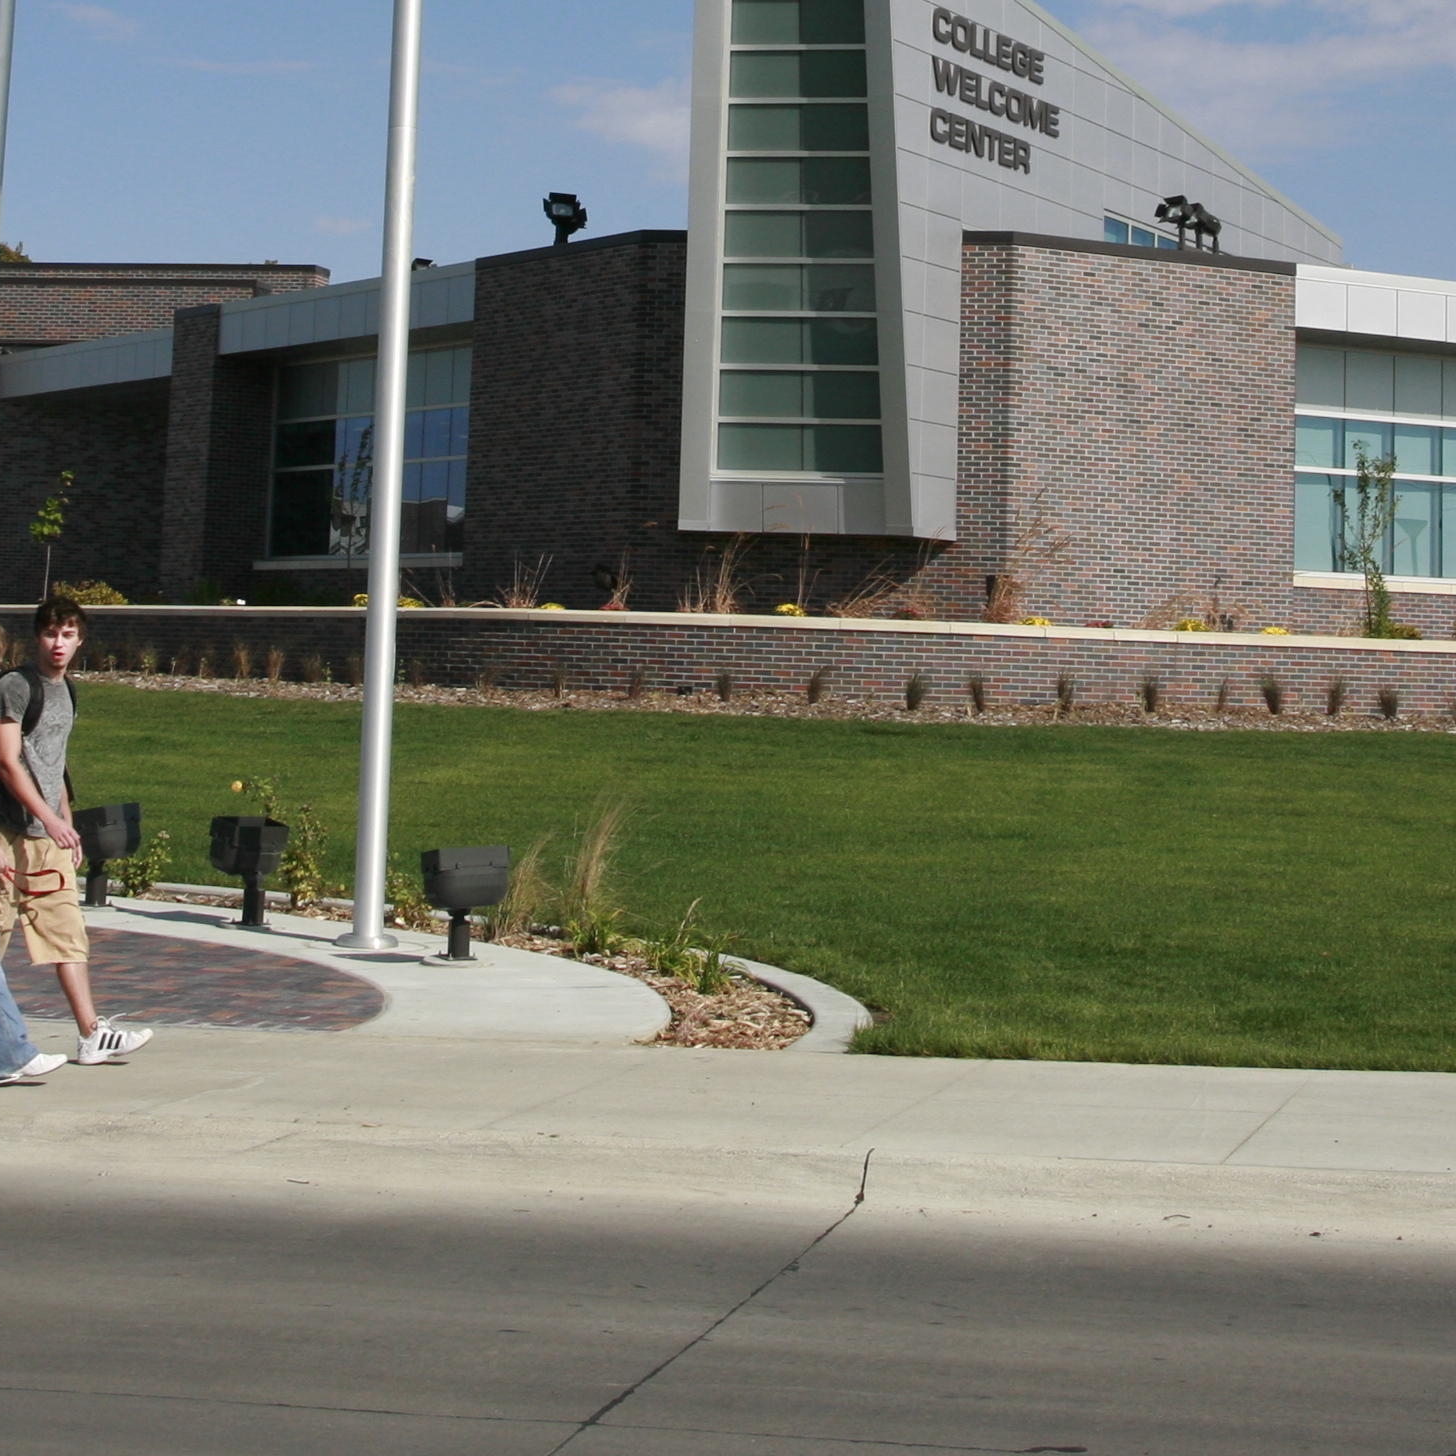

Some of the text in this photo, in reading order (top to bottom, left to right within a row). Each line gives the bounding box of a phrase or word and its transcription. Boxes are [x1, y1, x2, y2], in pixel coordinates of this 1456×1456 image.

[932, 7, 1044, 85] COLLEGE
[931, 55, 1060, 138] WELCOME
[930, 107, 1031, 174] CENTER
